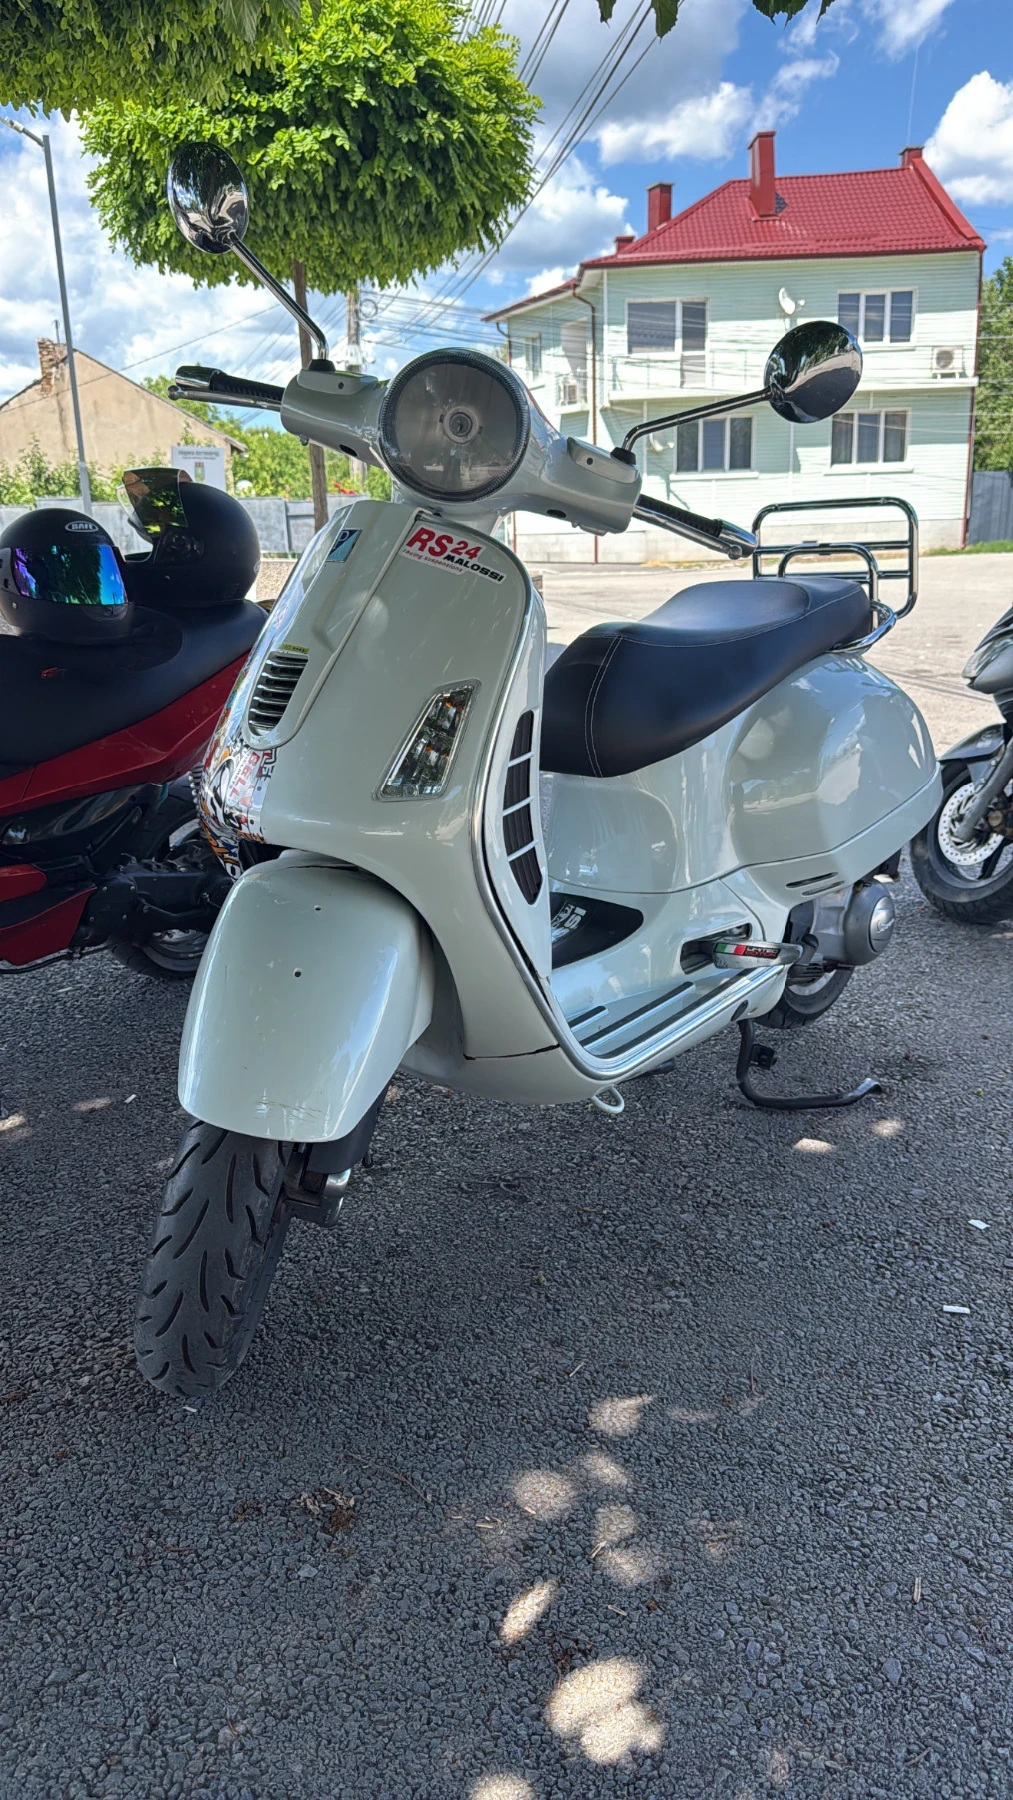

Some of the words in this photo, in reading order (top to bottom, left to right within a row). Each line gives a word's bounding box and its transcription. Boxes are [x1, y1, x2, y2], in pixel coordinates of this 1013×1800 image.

[402, 548, 423, 560] racing
[424, 556, 463, 573] suspensions
[443, 554, 504, 582] MALOSSI
[229, 751, 260, 798] BELL
